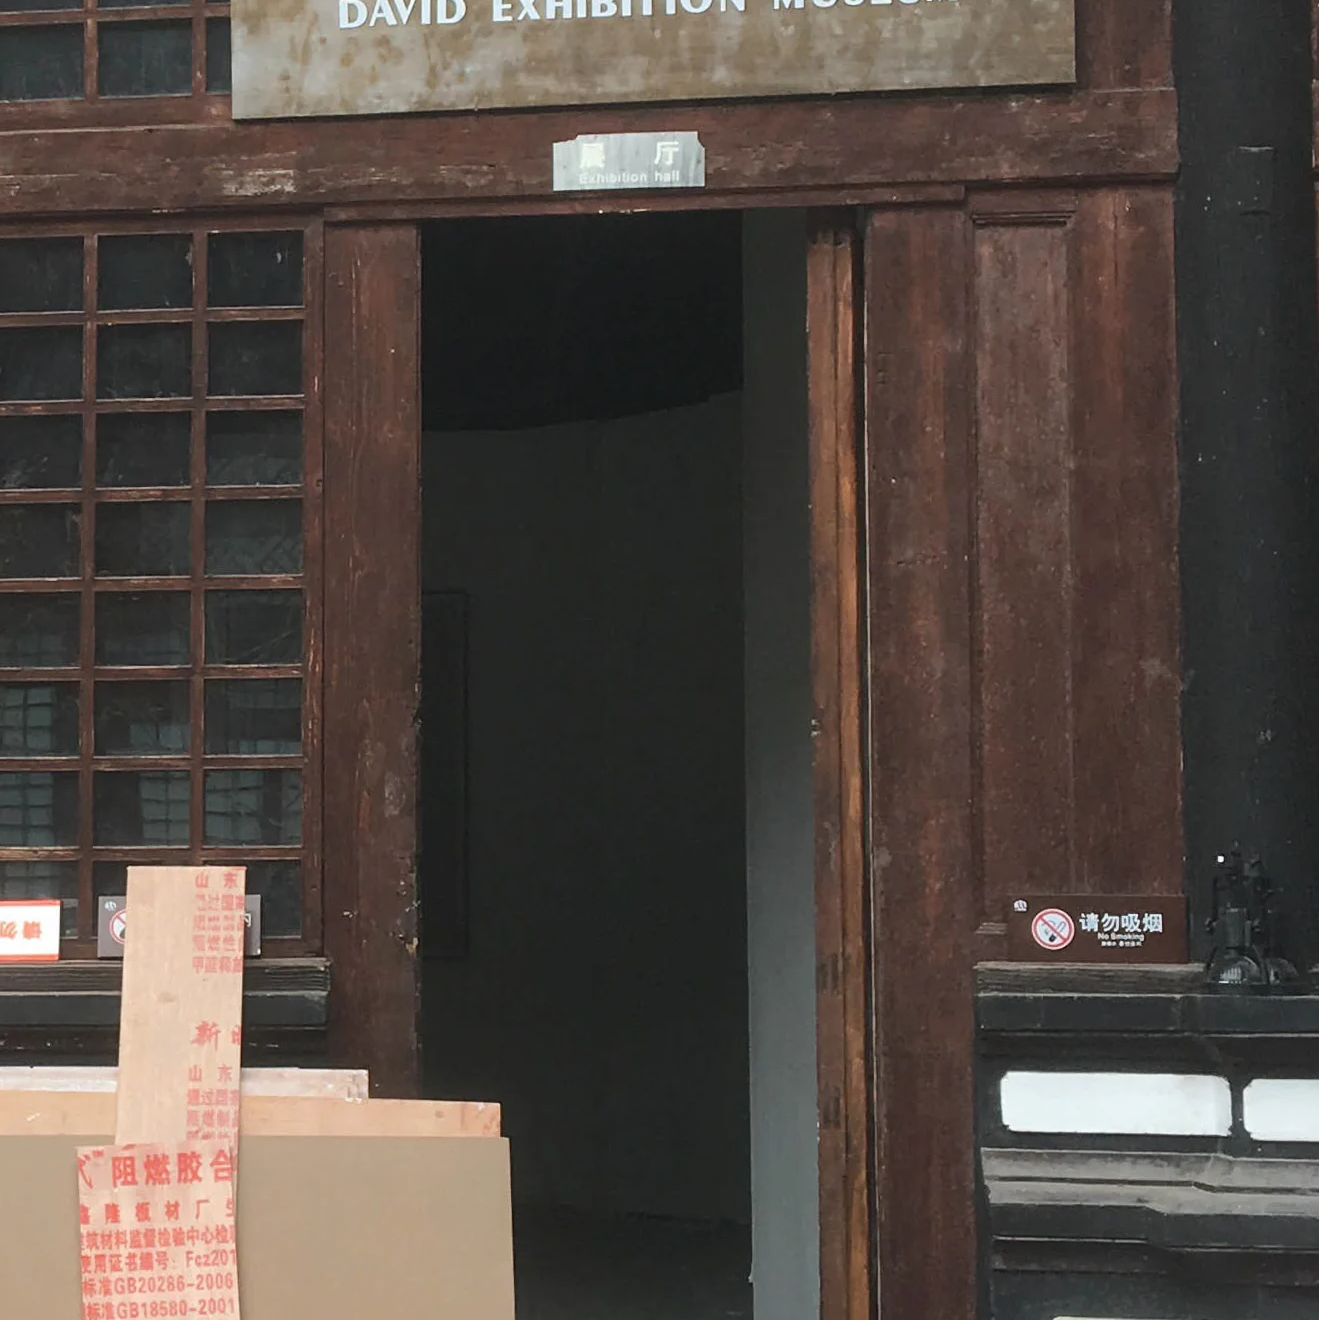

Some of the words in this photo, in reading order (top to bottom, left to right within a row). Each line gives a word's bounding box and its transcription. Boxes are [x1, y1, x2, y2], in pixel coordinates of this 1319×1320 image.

[579, 172, 647, 185] Exhibition
[654, 170, 680, 183] hall
[1080, 913, 1164, 933] 请勿吸烟
